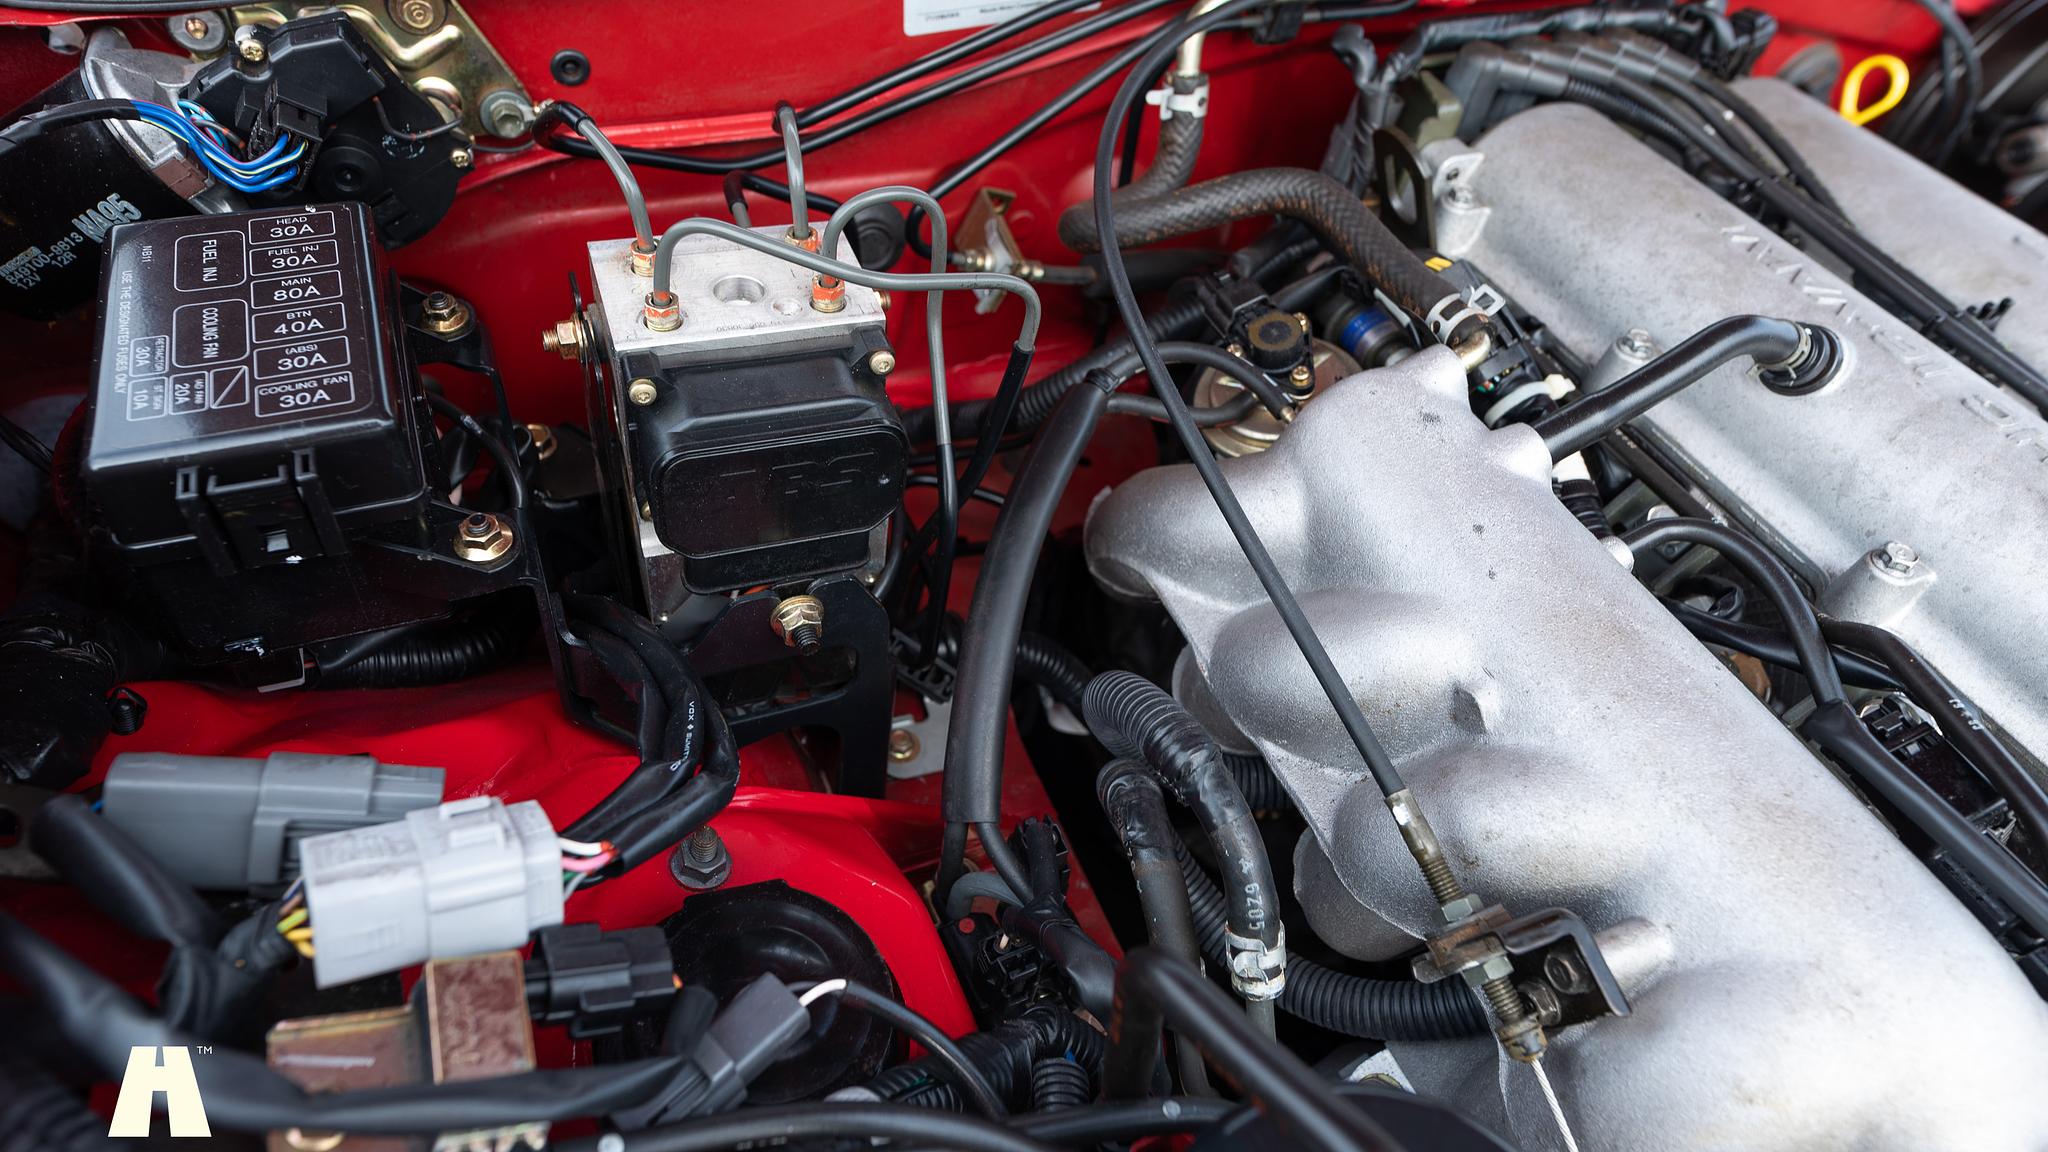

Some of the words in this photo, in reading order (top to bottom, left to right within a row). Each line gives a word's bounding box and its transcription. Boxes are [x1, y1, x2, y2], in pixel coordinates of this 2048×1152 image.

[71, 192, 141, 243] NA95
[276, 216, 307, 225] HEAD
[270, 223, 314, 238] 30A
[202, 239, 217, 264] FUEL
[268, 247, 297, 257] FUEL
[302, 244, 319, 252] INJ
[271, 253, 318, 269] 30A
[17, 272, 41, 291] 12V
[51, 250, 77, 268] 12R
[122, 270, 133, 284] USE
[202, 267, 218, 282] INJ
[281, 277, 312, 287] MAIN
[120, 285, 132, 300] THE
[273, 285, 321, 301] 80A
[117, 301, 131, 346] DESIGNATED
[202, 307, 219, 341] COOLING
[286, 310, 312, 320] BTN
[273, 318, 324, 335] 40A
[135, 346, 151, 367] 30A
[202, 342, 219, 359] FAN
[285, 343, 318, 355] (ABS)
[115, 347, 129, 372] FUSES
[277, 352, 328, 371] 30A
[114, 373, 128, 394] ONLY
[259, 380, 318, 396] COOLING
[323, 375, 348, 386] FAN
[132, 388, 149, 410] 10A
[174, 383, 191, 405] 20A
[279, 389, 331, 408] 30A
